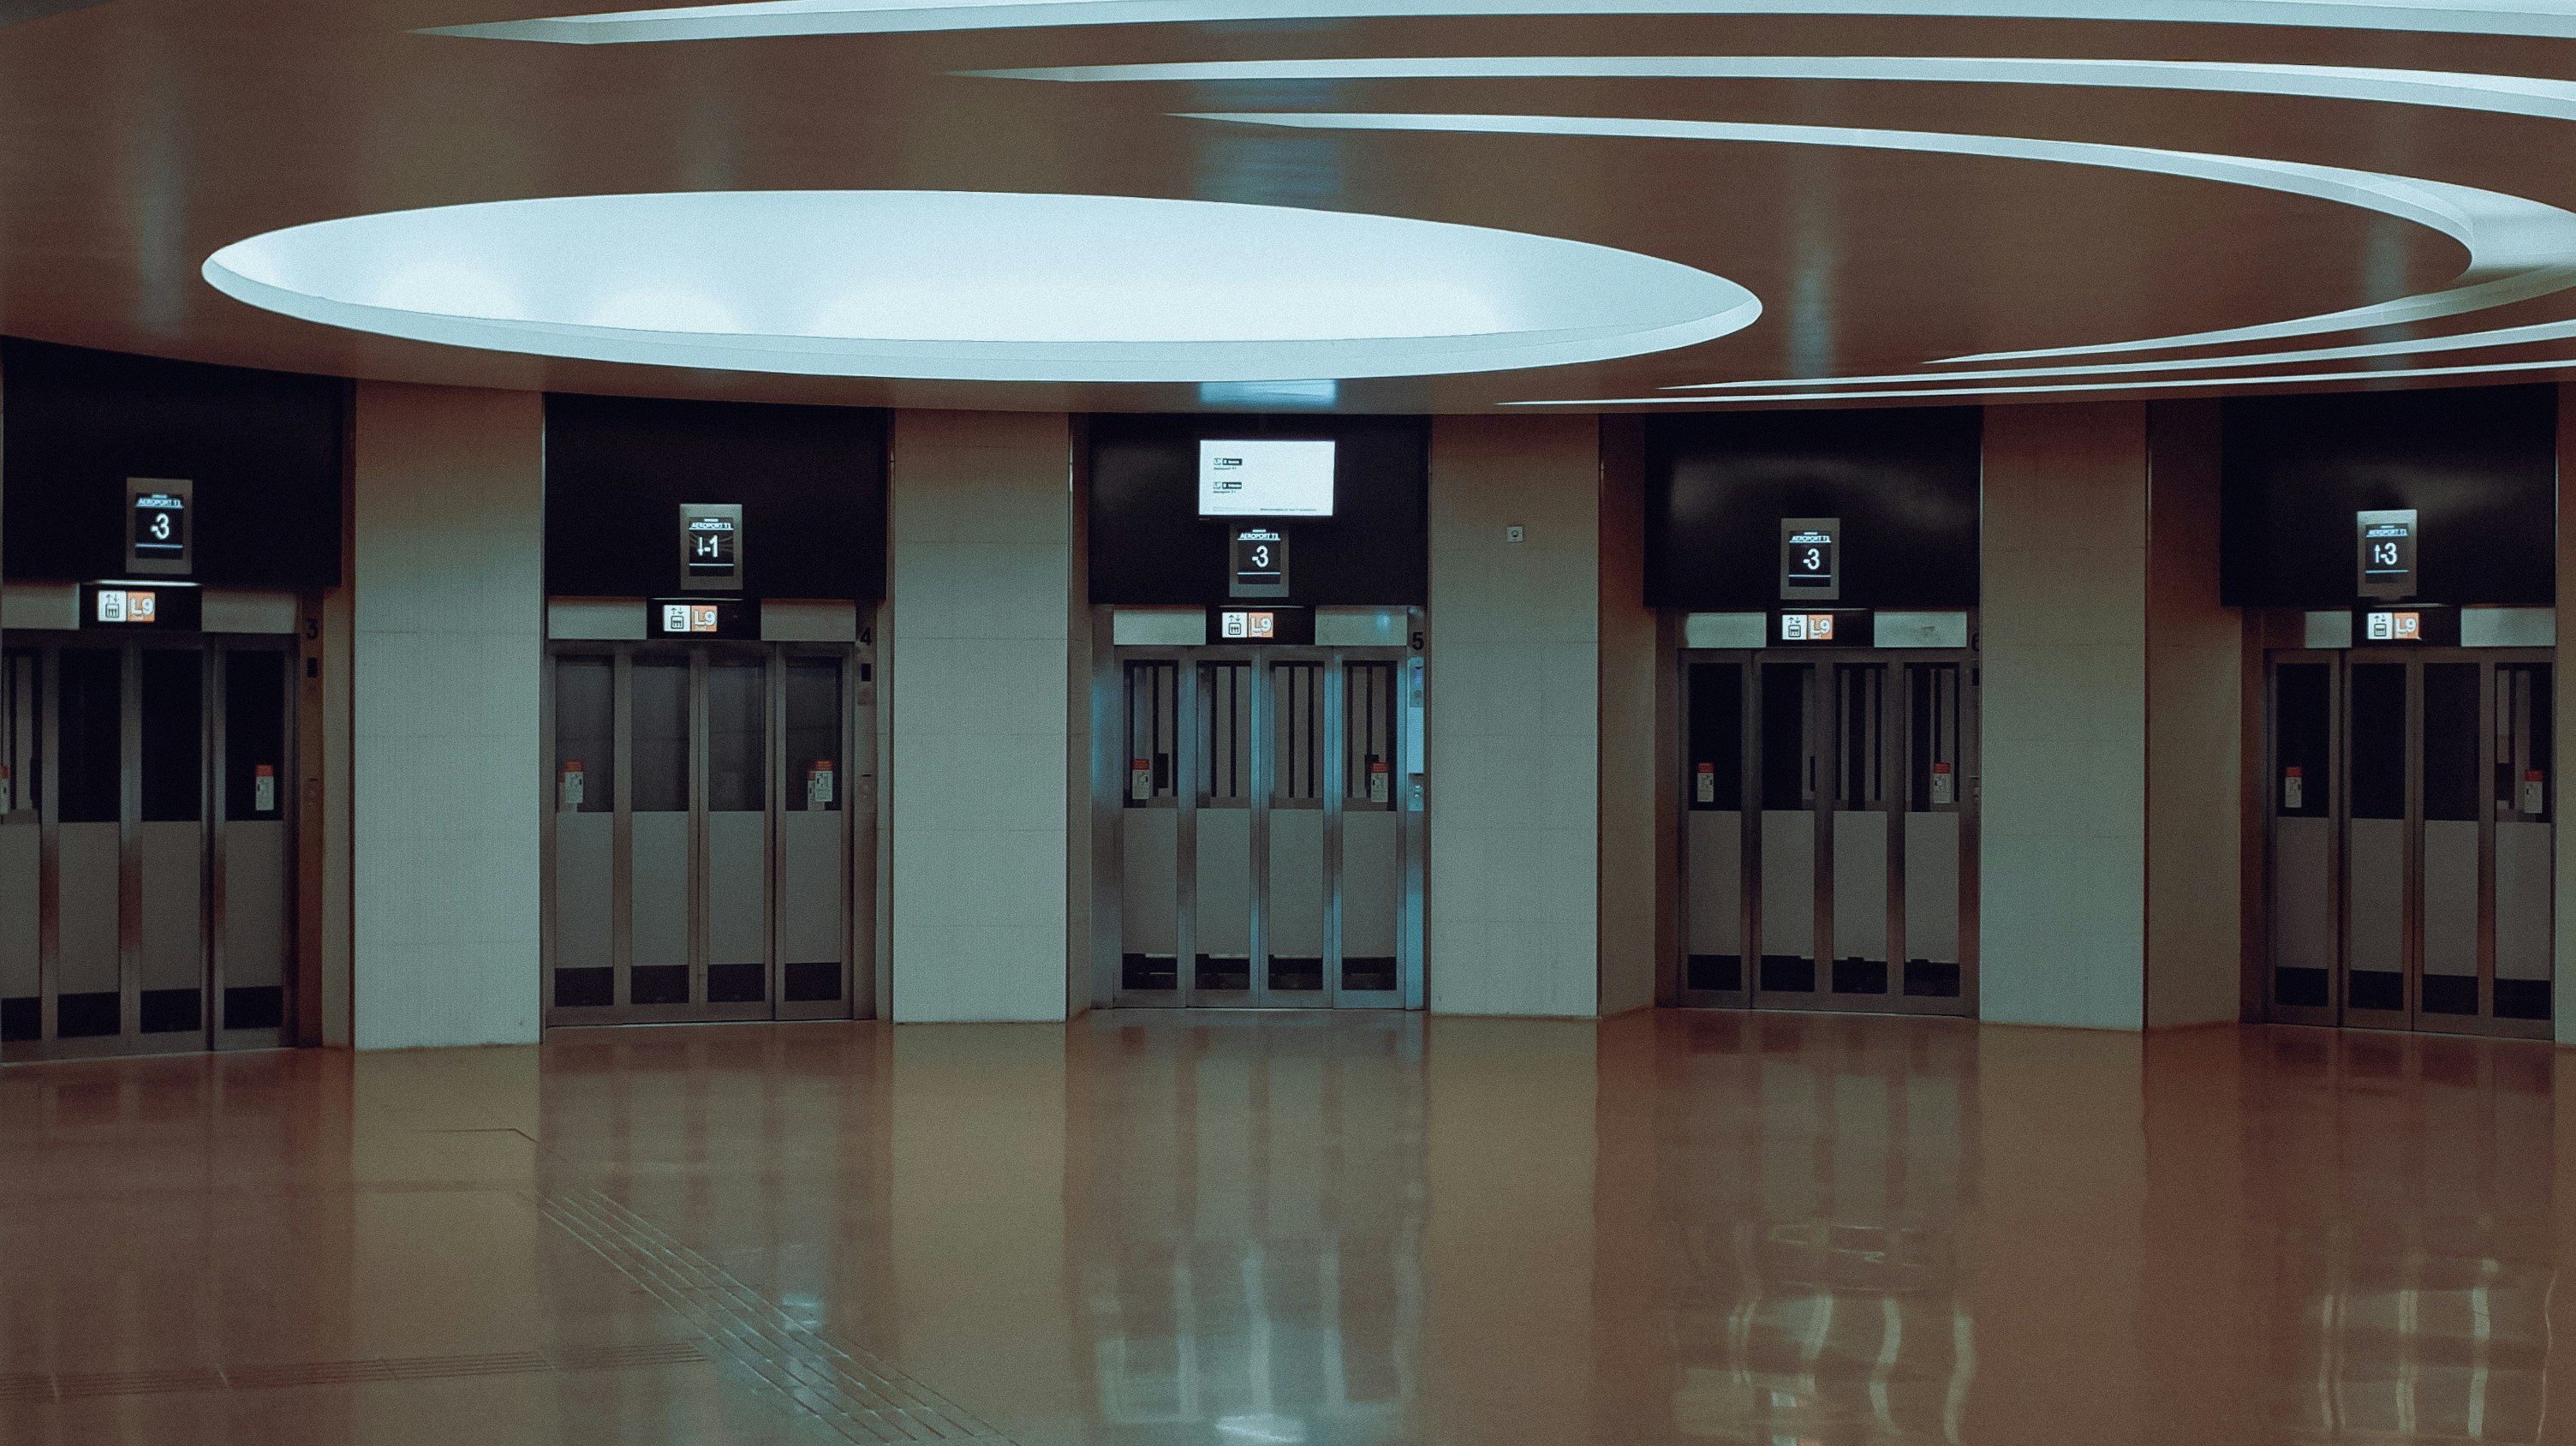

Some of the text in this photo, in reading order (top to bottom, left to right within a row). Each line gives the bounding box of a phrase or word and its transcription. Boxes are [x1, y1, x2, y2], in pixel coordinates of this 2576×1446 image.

[151, 513, 170, 540] -3
[704, 535, 719, 558] -1
[2381, 542, 2398, 565] -3
[1251, 545, 1269, 568] -3
[1803, 548, 1821, 571] -3
[131, 598, 154, 615] L9
[695, 610, 716, 626] L9
[1251, 617, 1272, 632] L9
[1809, 618, 1830, 634] L9
[2395, 618, 2416, 633] L9
[307, 618, 319, 640] 3
[860, 627, 872, 646] 4
[1413, 632, 1424, 650] 5
